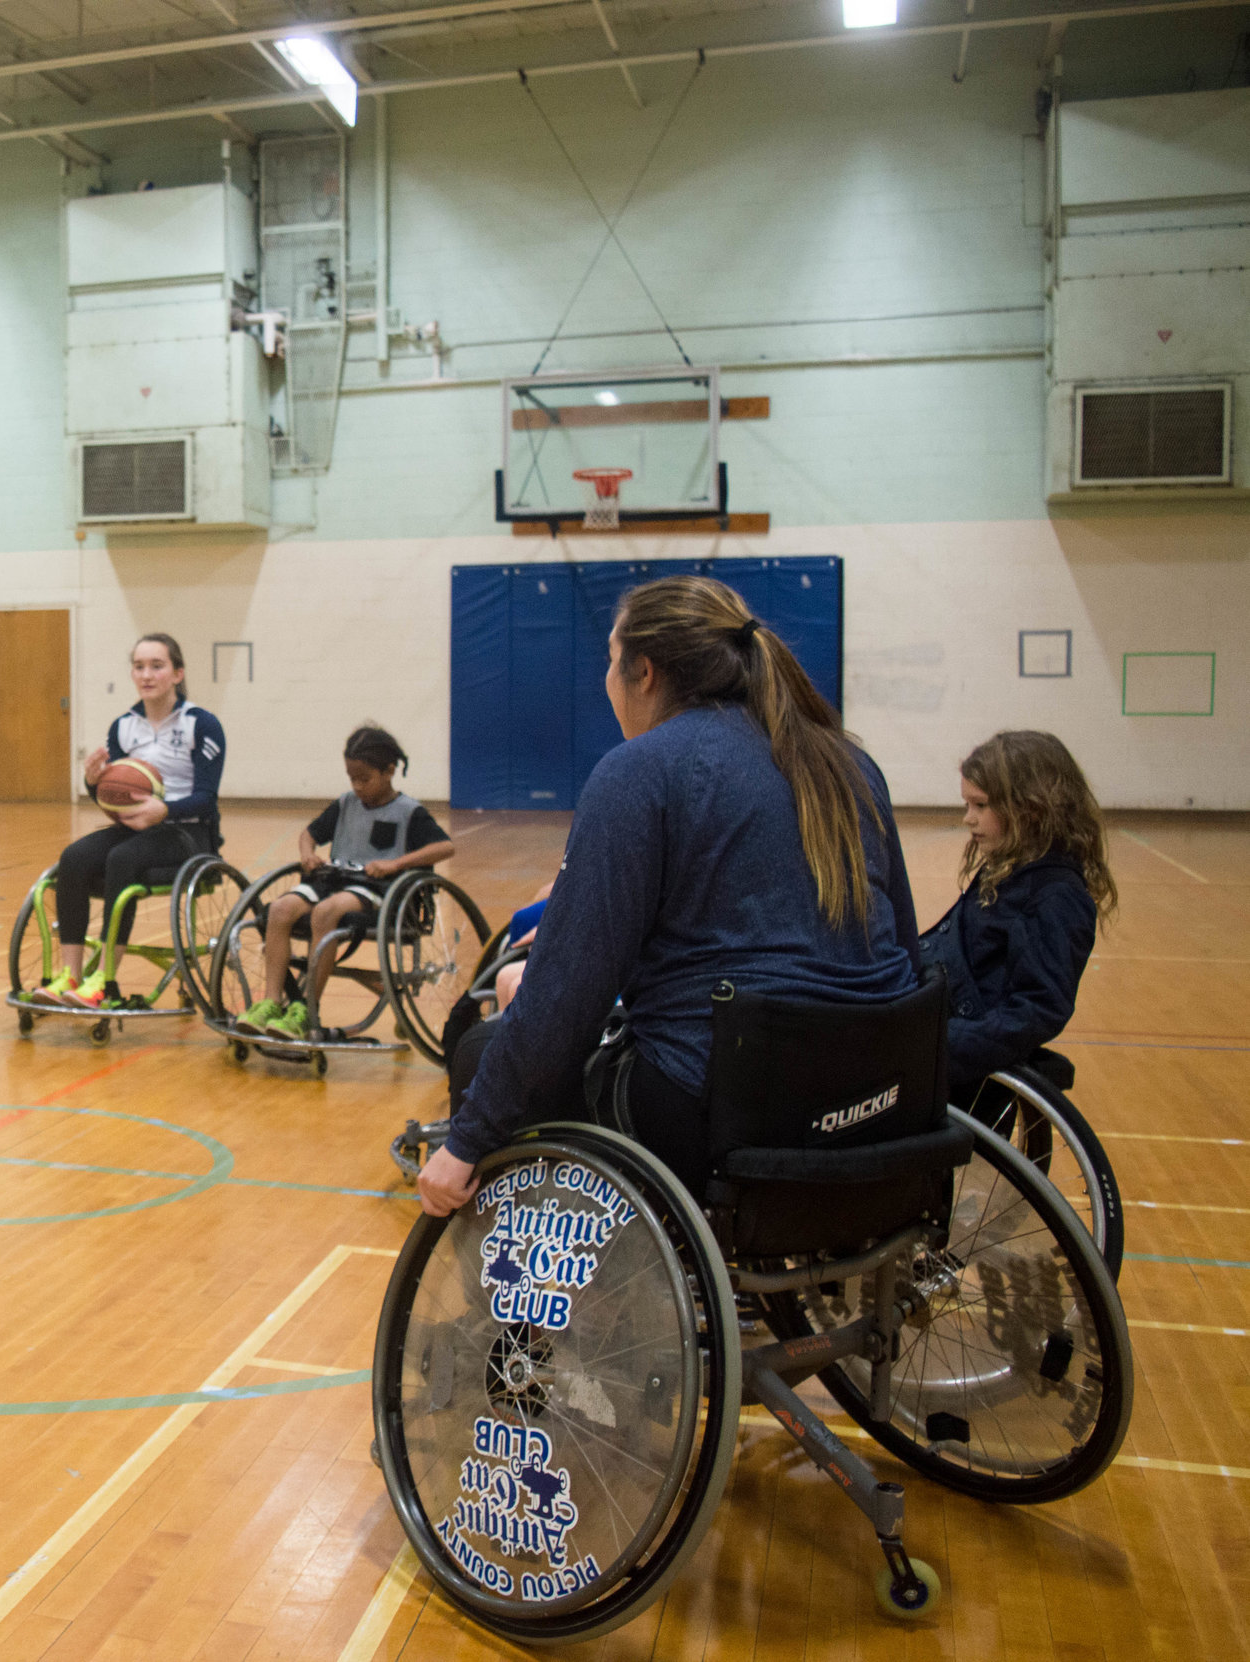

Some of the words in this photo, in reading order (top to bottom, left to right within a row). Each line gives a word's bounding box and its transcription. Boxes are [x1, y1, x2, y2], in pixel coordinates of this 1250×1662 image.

[821, 1084, 899, 1132] QUICKIE
[477, 1163, 548, 1214] PICTOU
[554, 1163, 638, 1225] COUNTY
[484, 1198, 614, 1252] Antique
[528, 1241, 597, 1287] Car
[493, 1289, 570, 1328] CLUB
[475, 1418, 551, 1464] CLUB
[460, 1459, 518, 1510] Car
[454, 1497, 576, 1565] Antique
[437, 1519, 513, 1594] COUNTY
[522, 1556, 600, 1599] PICTOU
